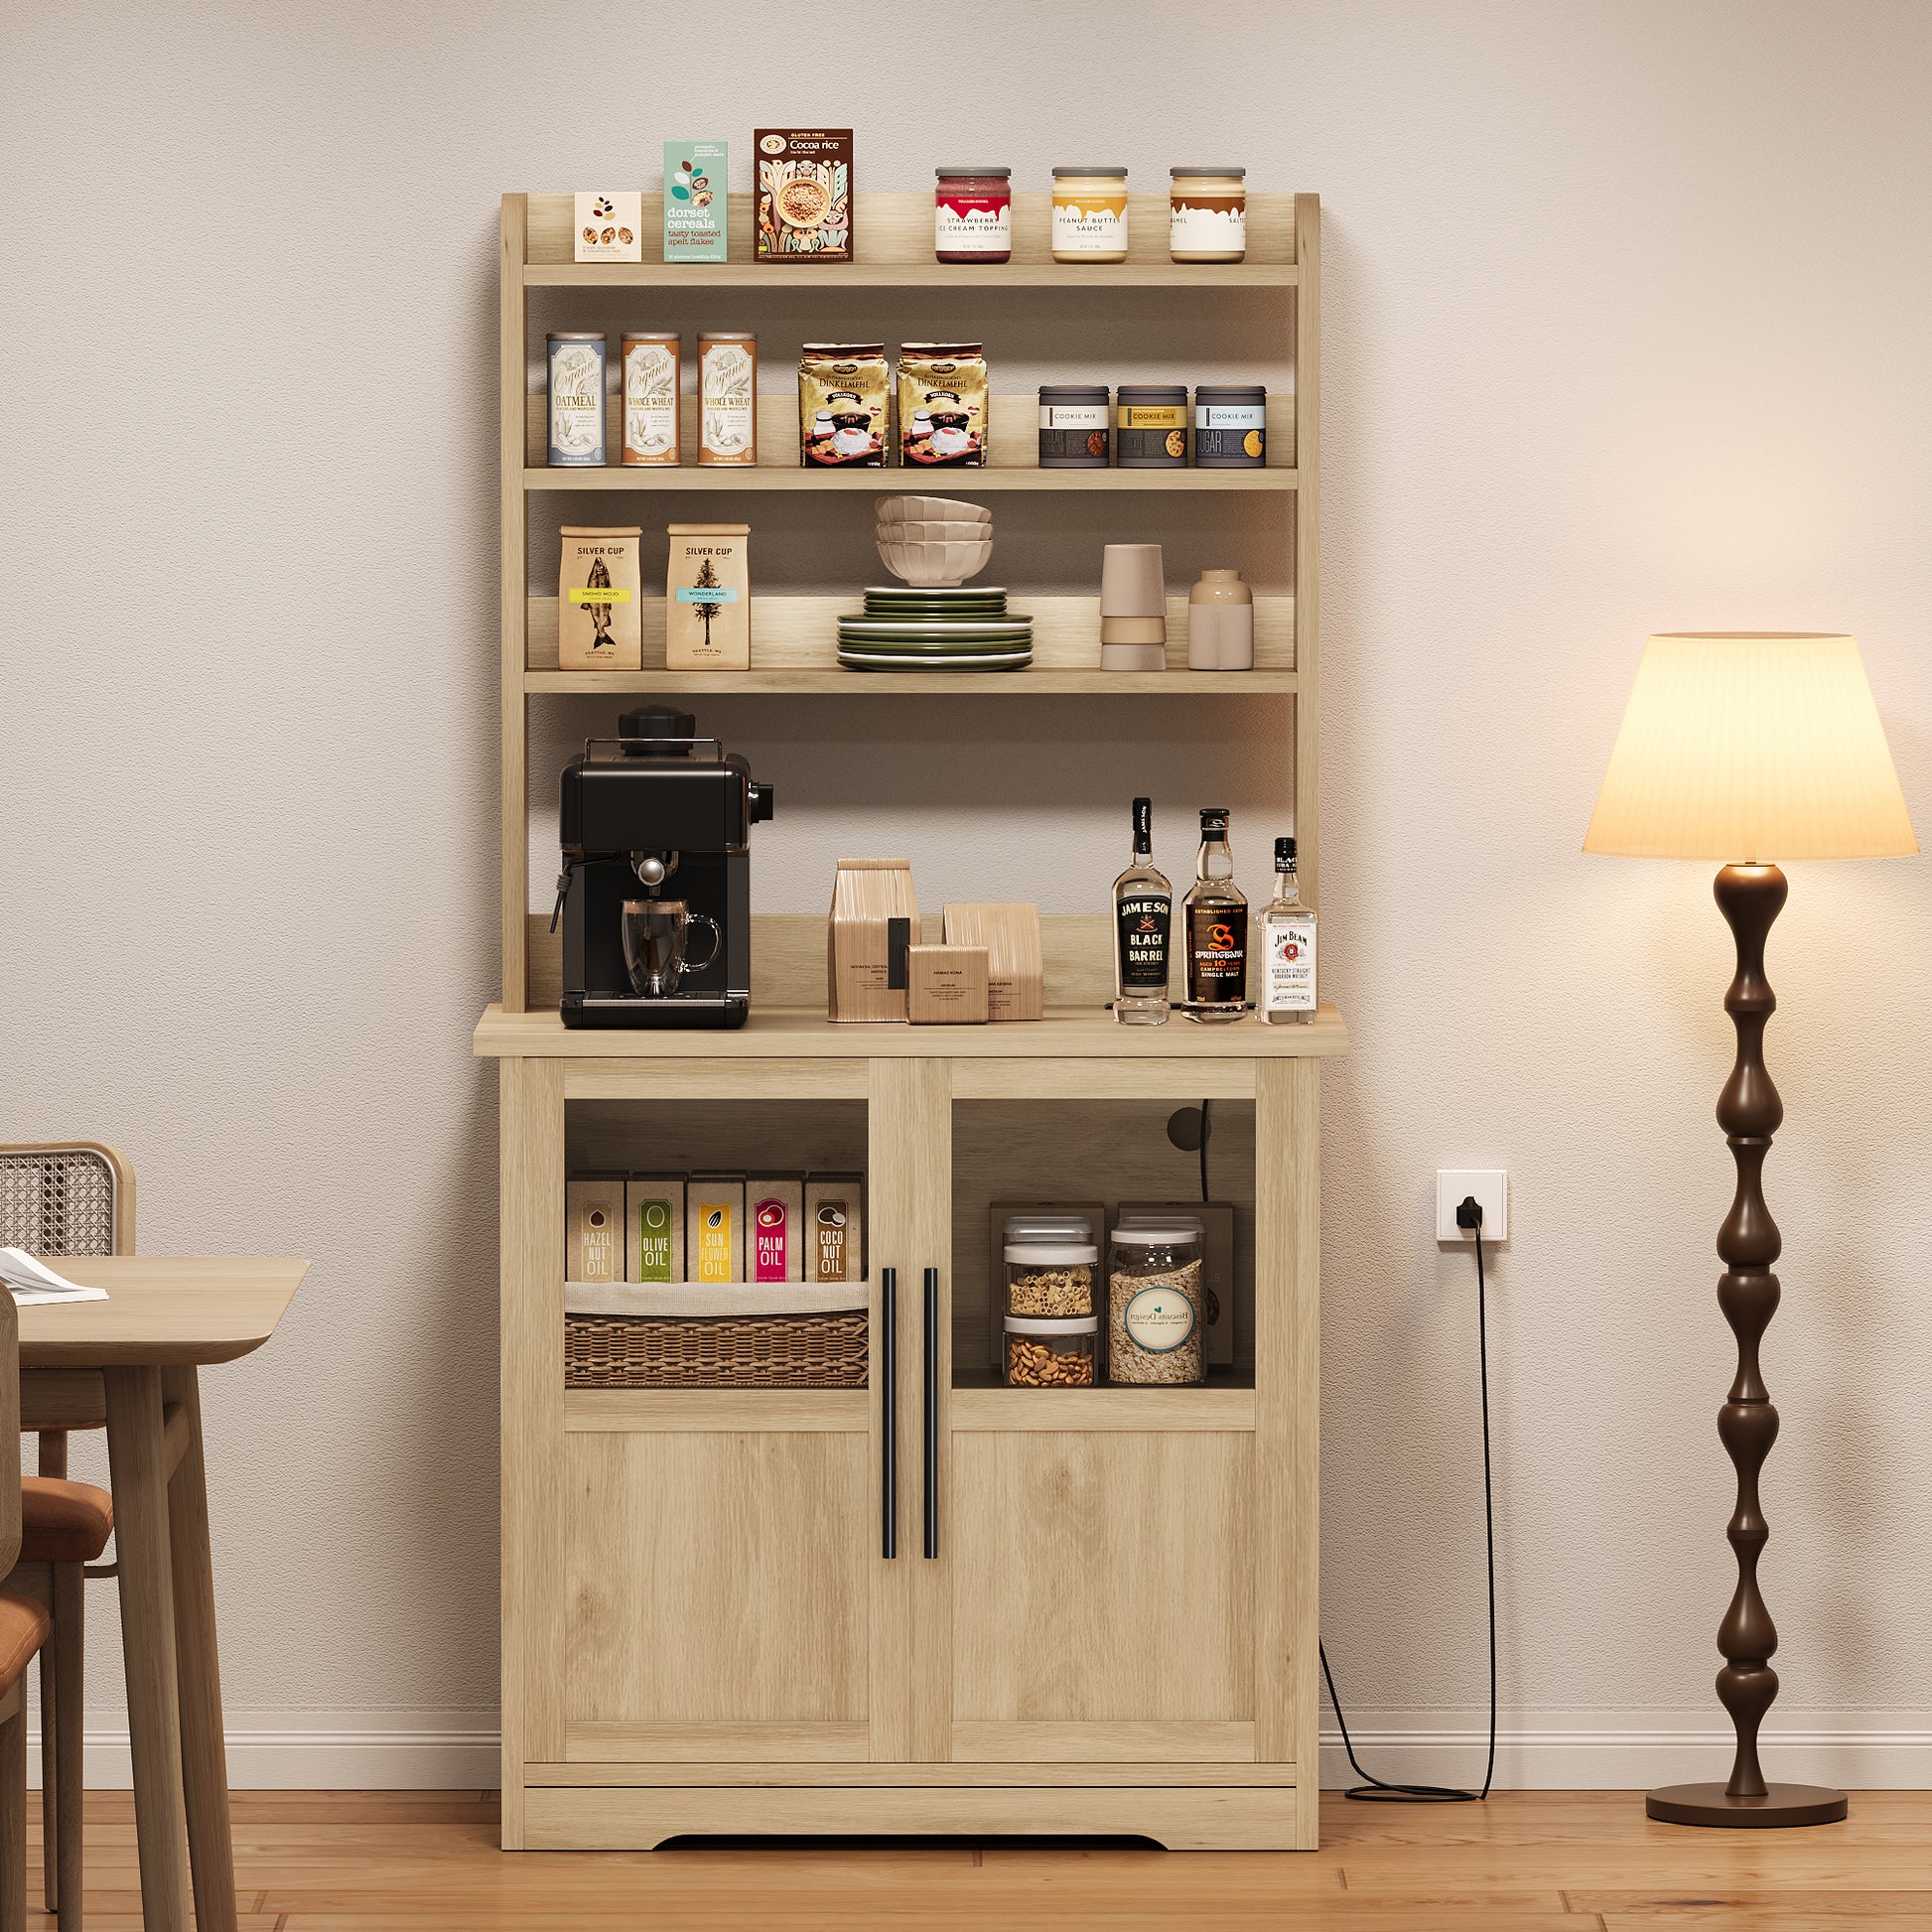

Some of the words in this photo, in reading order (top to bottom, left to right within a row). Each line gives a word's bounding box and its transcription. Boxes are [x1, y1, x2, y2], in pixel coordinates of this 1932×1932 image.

[790, 140, 820, 149] Cocoa
[822, 140, 839, 149] rice
[667, 207, 710, 218] dorset
[667, 218, 715, 229] cereals
[553, 358, 595, 393] Organic
[628, 358, 668, 393] Organic
[705, 358, 746, 393] Organic
[819, 378, 869, 388] DINKELMEHL
[918, 378, 967, 388] DINKELMEHL
[556, 396, 596, 407] OATMEAL
[628, 398, 650, 406] WHOLE
[652, 398, 674, 406] WHEAT
[705, 398, 726, 406] WHOLE
[728, 398, 750, 406] WHEAT
[1122, 902, 1169, 917] JAMESON
[1130, 934, 1163, 946] BLACK
[1274, 934, 1287, 947] JIM
[1289, 931, 1307, 946] BEAM
[1129, 950, 1163, 962] BARREL
[1195, 950, 1243, 959] SPRINGBANK
[583, 1232, 610, 1246] HAZEL
[643, 1238, 668, 1251] OLIVE
[706, 1233, 723, 1247] SUN
[759, 1237, 783, 1251] PALM
[820, 1231, 843, 1244] COCO
[589, 1247, 606, 1260] NUT
[645, 1252, 666, 1266] OIL
[701, 1247, 728, 1261] FLOWER
[760, 1251, 782, 1266] OIL
[823, 1245, 841, 1259] NUT
[587, 1261, 608, 1275] OIL
[704, 1261, 725, 1275] OIL
[822, 1259, 843, 1274] OIL
